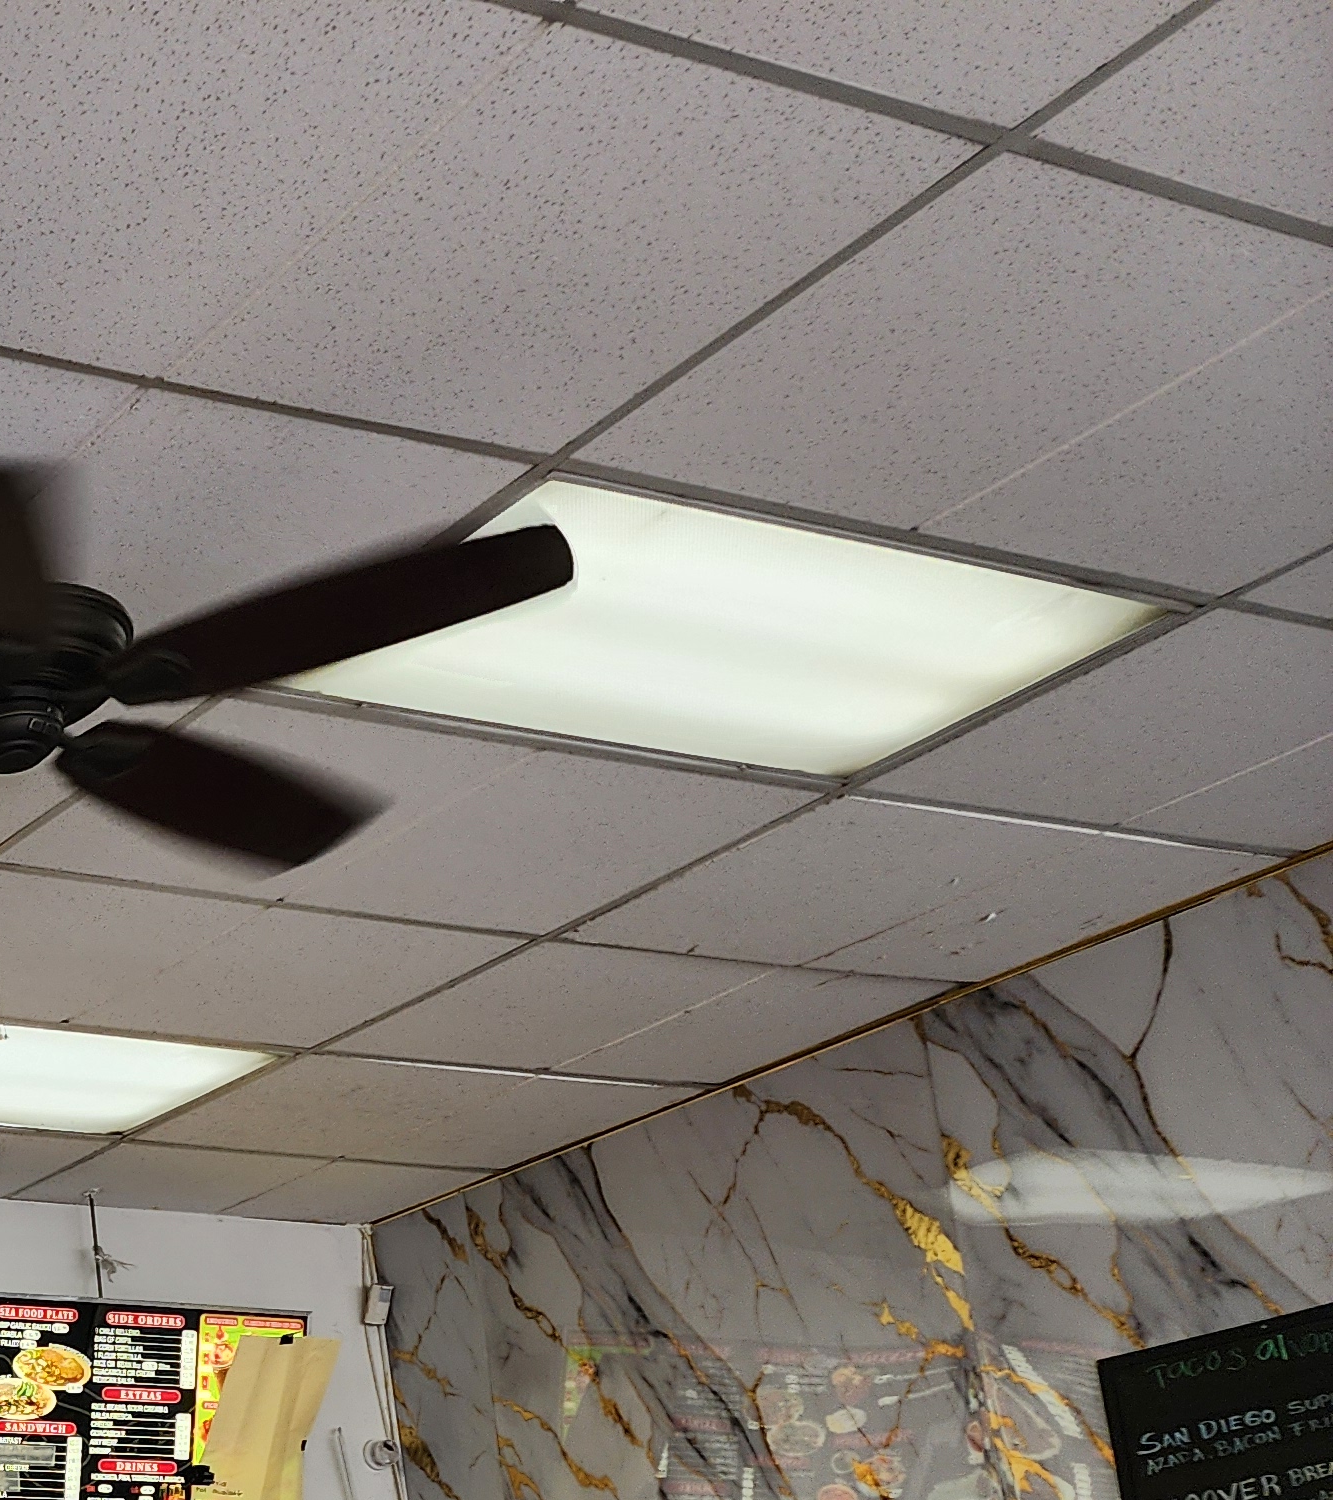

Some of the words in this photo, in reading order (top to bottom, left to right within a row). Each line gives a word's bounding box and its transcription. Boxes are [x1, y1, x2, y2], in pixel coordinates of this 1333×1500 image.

[0, 1307, 16, 1317] SEA
[19, 1308, 44, 1318] FOOD
[46, 1309, 74, 1320] PLATE
[108, 1314, 134, 1325] SIDE
[137, 1315, 182, 1327] ORDERS
[120, 1391, 162, 1401] EXTRAS
[4, 1422, 66, 1434] SANDWICH
[1136, 1427, 1191, 1456] SAN
[1198, 1409, 1276, 1440] DIEGO
[1286, 1393, 1333, 1415] SUP
[1214, 1426, 1282, 1457] BACON
[116, 1462, 158, 1472] DRINKS
